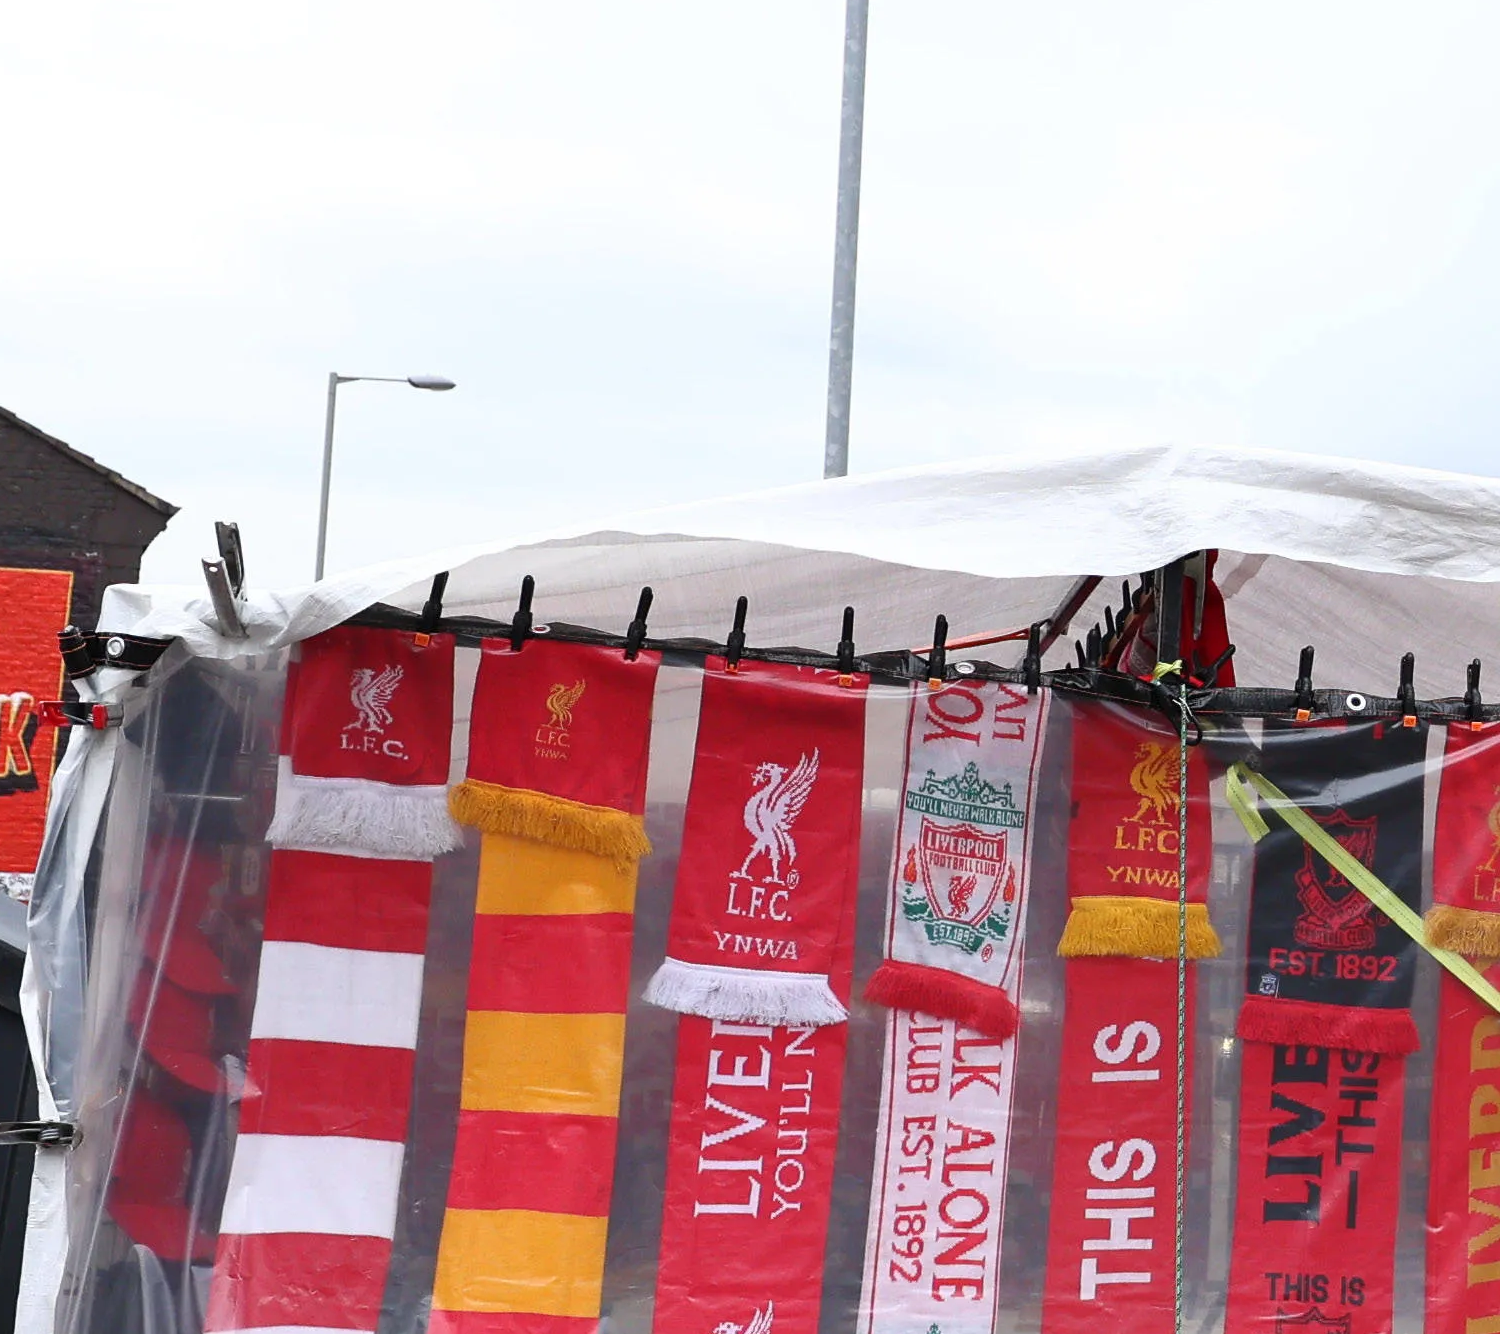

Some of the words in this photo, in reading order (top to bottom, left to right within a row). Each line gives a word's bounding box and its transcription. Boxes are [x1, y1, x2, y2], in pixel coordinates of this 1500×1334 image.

[340, 733, 409, 760] L.F.C.
[535, 729, 570, 748] L.F.C.
[907, 792, 939, 811] YOU'LL
[940, 798, 970, 819] NEVER
[971, 803, 995, 824] WALK
[995, 808, 1025, 827] ALONE
[926, 832, 1001, 860] LIVERPOOL
[928, 853, 974, 873] FOOTBALL
[975, 861, 998, 877] CLUB
[1106, 864, 1181, 889] YNWA
[725, 882, 793, 922] L.F.C.
[712, 930, 799, 961] YNWA
[1268, 947, 1326, 978] EST.
[1335, 954, 1398, 982] 1892
[905, 1012, 945, 1095] LUB
[1091, 1020, 1161, 1083] IS
[770, 1069, 813, 1219] YOU'LL
[898, 1115, 937, 1193] EST.
[931, 1117, 997, 1303] ALONE
[1080, 1137, 1157, 1301] THIS
[889, 1201, 928, 1284] 1892
[1264, 1272, 1329, 1304] THIS
[1340, 1275, 1366, 1307] IS
